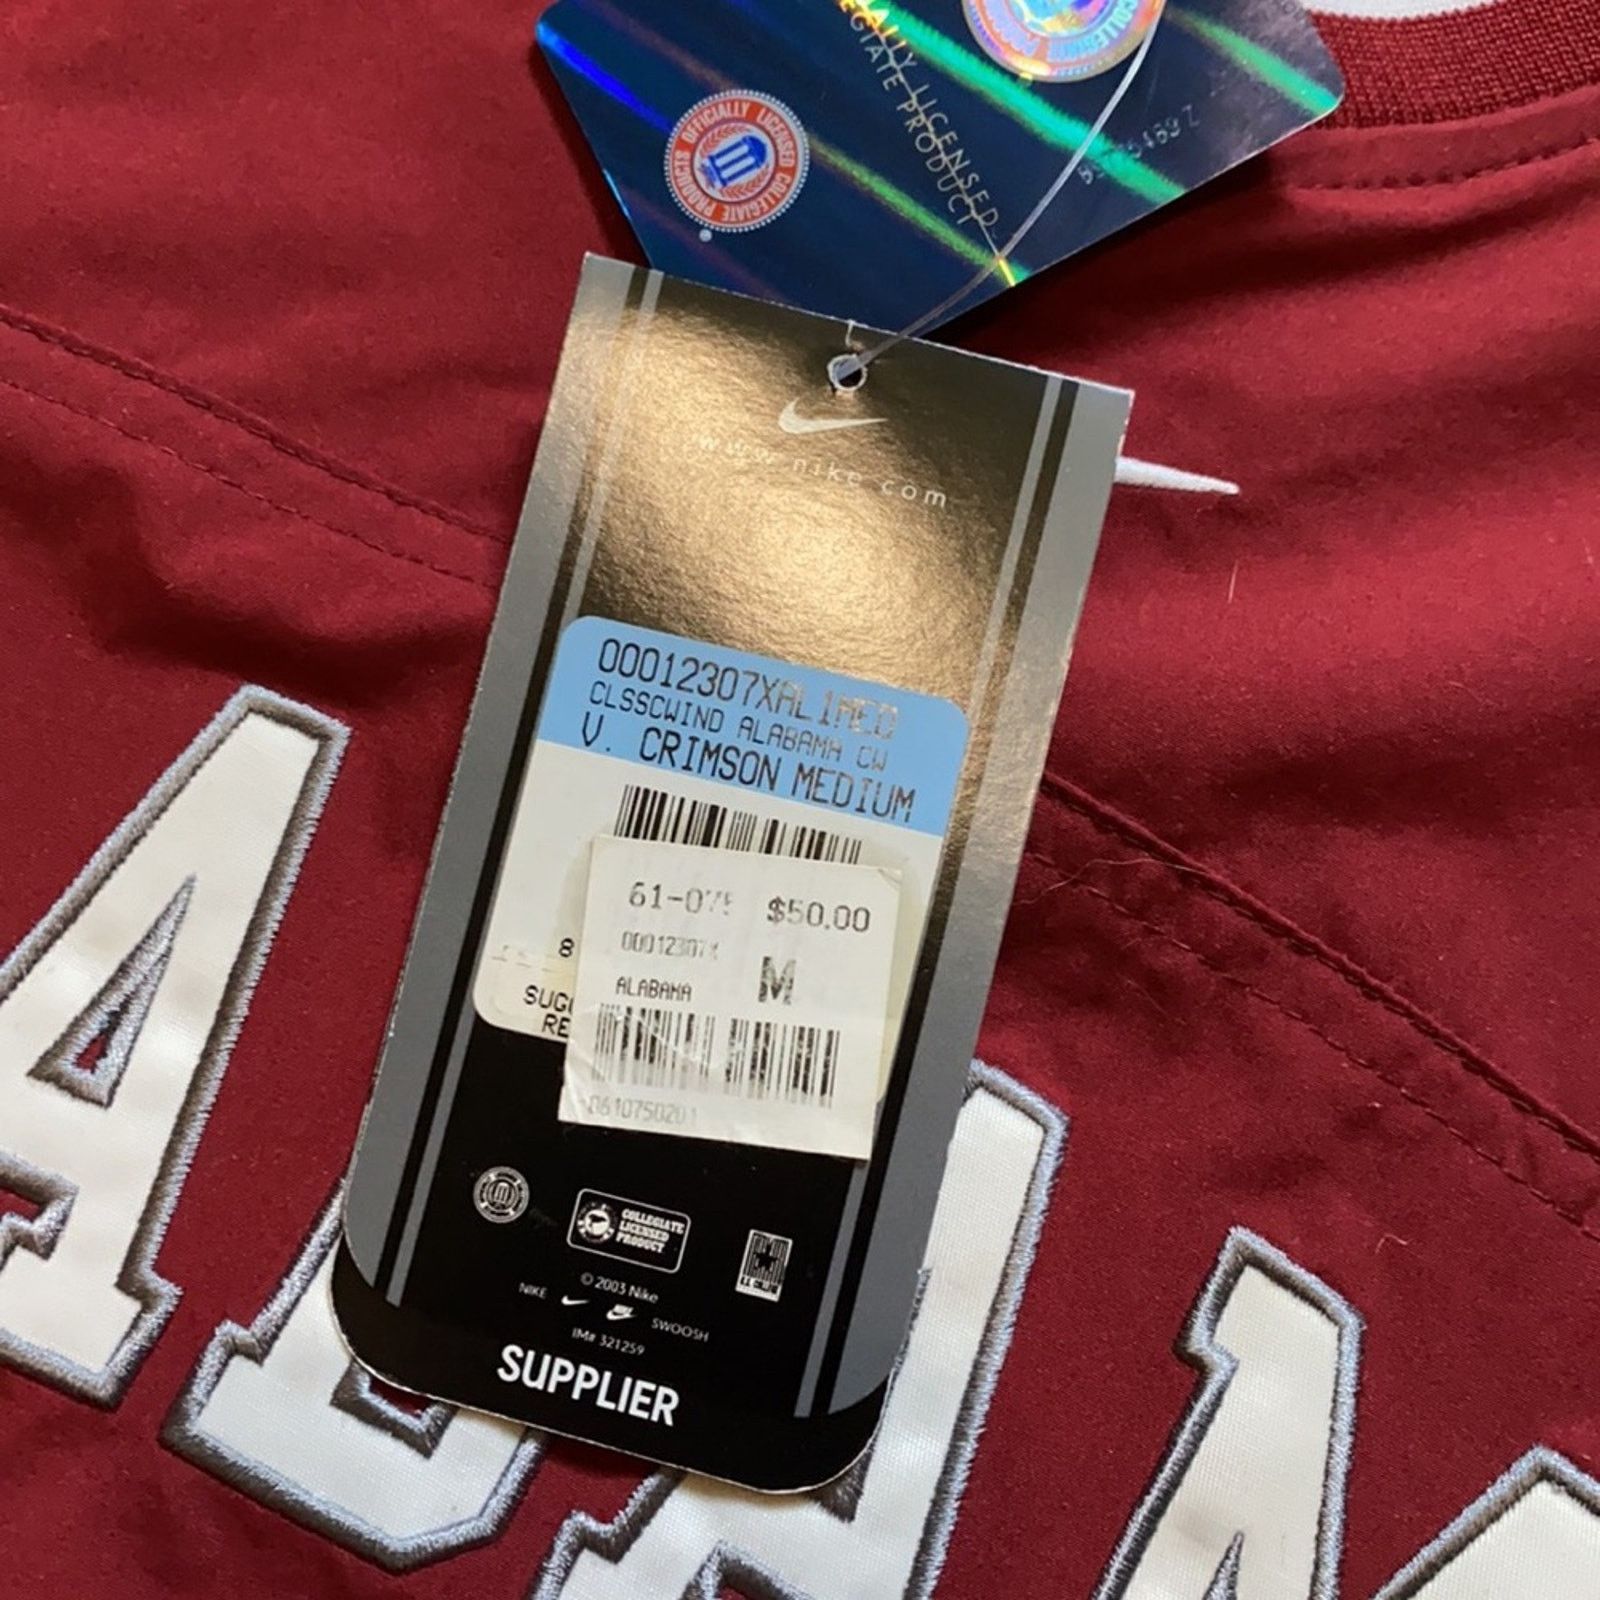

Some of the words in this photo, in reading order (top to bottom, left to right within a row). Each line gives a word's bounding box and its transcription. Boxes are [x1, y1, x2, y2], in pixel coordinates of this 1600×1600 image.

[681, 100, 751, 144] OFFICIALLY
[756, 107, 796, 167] LICENSED
[897, 100, 976, 224] PRODUCT
[912, 85, 998, 226] LICENSED
[673, 150, 717, 217] PRODUCTS
[721, 172, 791, 221] COLLEGIATE
[589, 680, 725, 733] CLSSCWIND
[737, 715, 843, 763] ALABAMA
[581, 711, 611, 752] V.
[638, 726, 783, 792] CRIMSON
[790, 762, 916, 823] MEDIUM
[766, 896, 871, 933] $50.00
[615, 976, 693, 1002] ALABAMA
[757, 955, 797, 1005] M
[616, 1231, 666, 1253] PRODUCT
[619, 1220, 670, 1242] LICENSED
[621, 1208, 685, 1234] COLLEGIATE
[517, 1281, 549, 1300] NIKE
[594, 1276, 626, 1295] 2003
[628, 1284, 659, 1304] Nike
[599, 1334, 645, 1356] 321259
[651, 1317, 710, 1343] SWOOSH
[496, 1343, 681, 1428] SUPPLIER
